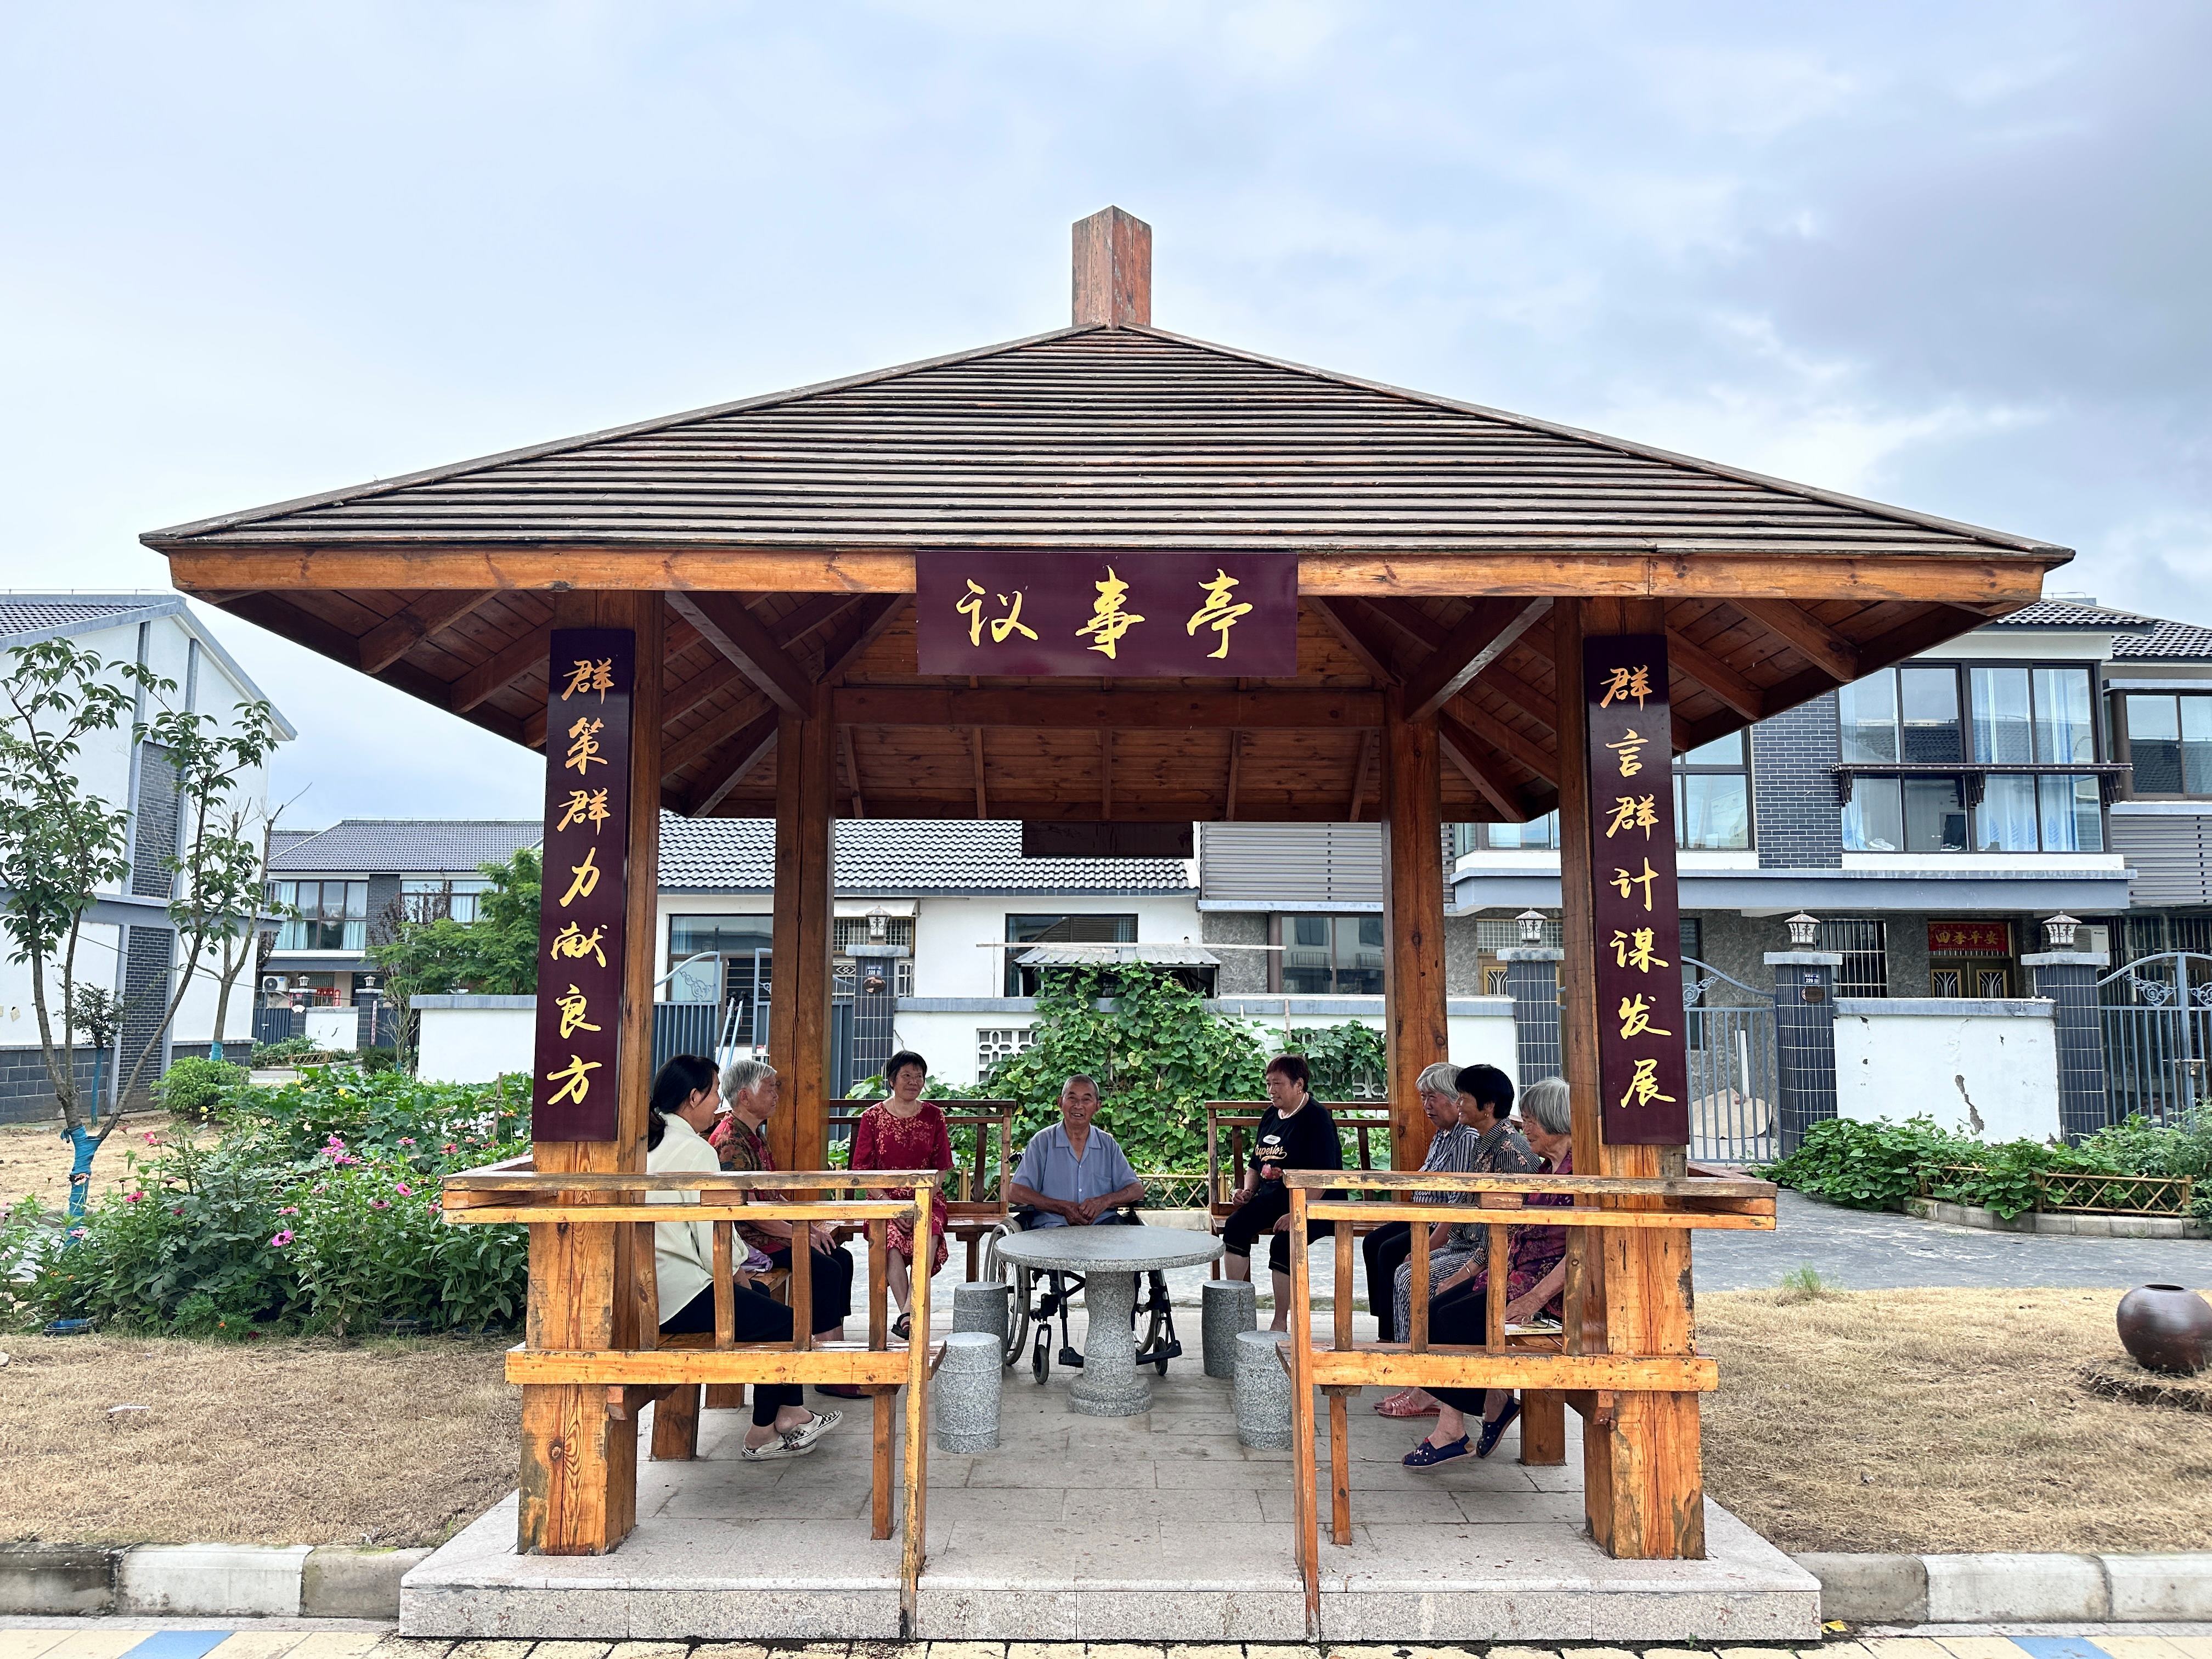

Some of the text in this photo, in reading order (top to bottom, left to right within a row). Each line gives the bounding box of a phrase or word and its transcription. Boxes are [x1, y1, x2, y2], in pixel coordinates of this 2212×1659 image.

[956, 565, 1253, 659] 议事亭
[547, 657, 615, 1105] 群策群力献良方
[1599, 664, 1676, 1108] 群言群计谋发展
[1936, 930, 1999, 945] 四季平安
